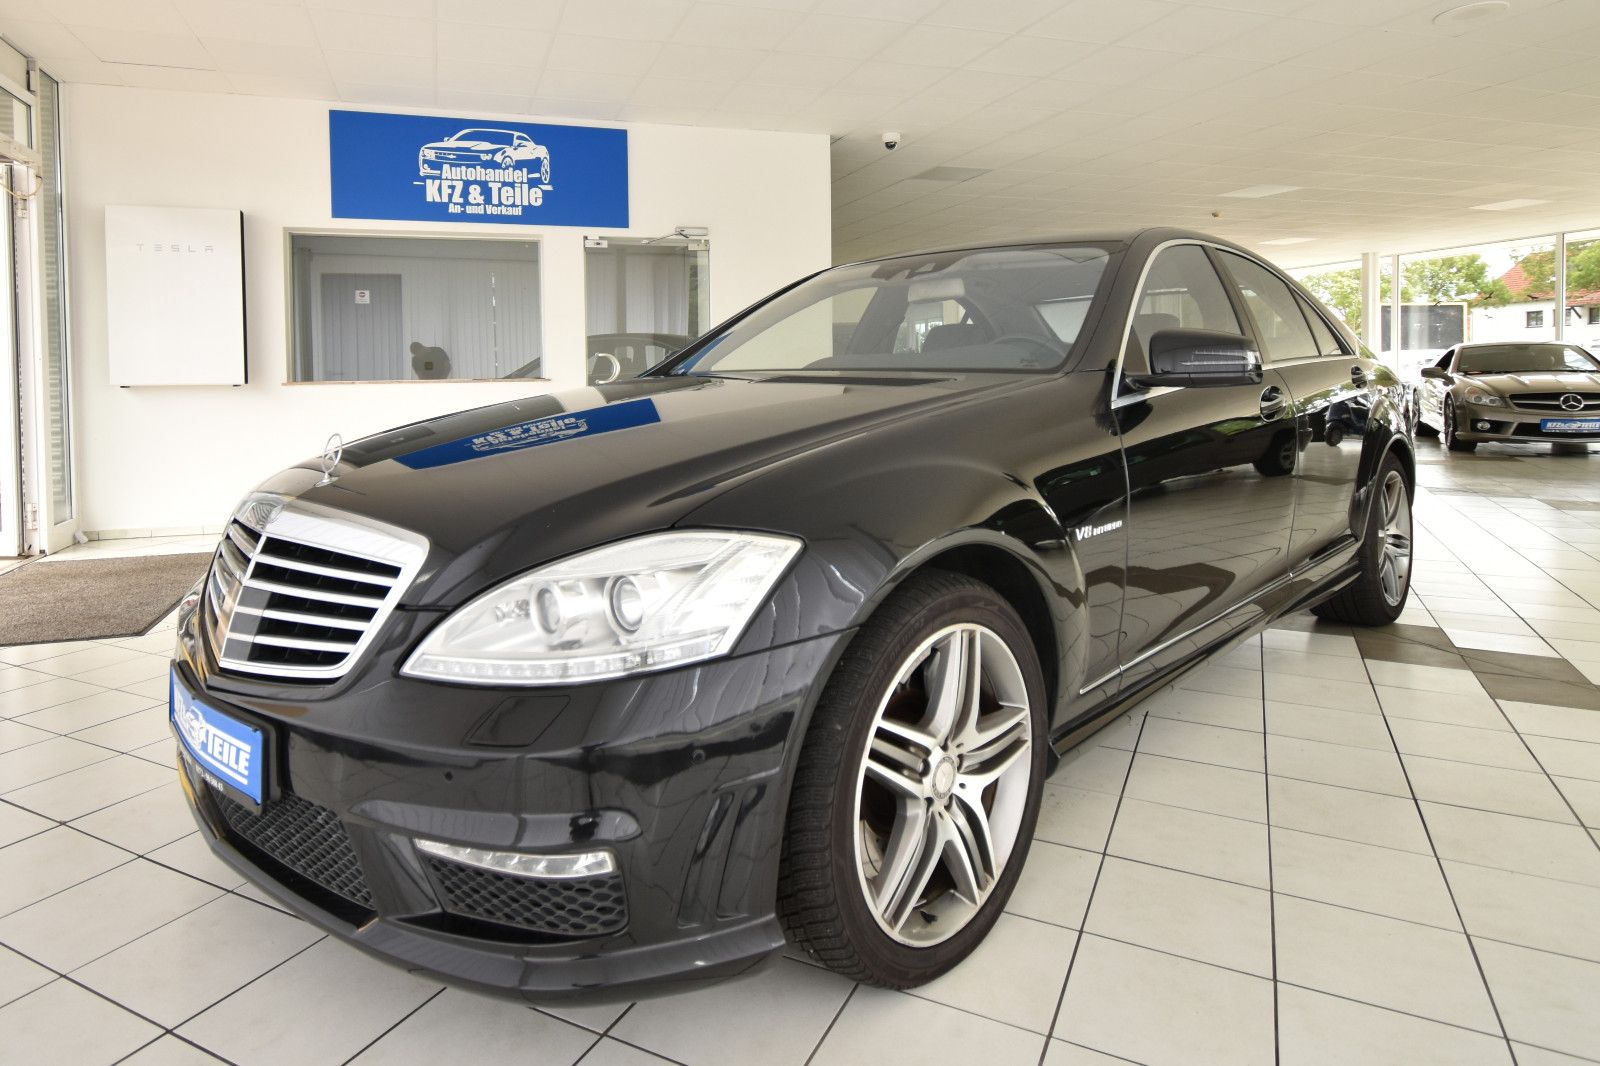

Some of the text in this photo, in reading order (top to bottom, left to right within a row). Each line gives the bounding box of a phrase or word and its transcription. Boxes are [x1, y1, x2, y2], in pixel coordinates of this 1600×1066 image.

[441, 164, 528, 182] Autohandel
[425, 179, 543, 206] KFZ & Teile
[448, 203, 522, 216] An- und Verkauf
[136, 243, 214, 253] TESLA
[206, 722, 251, 776] TEILE
